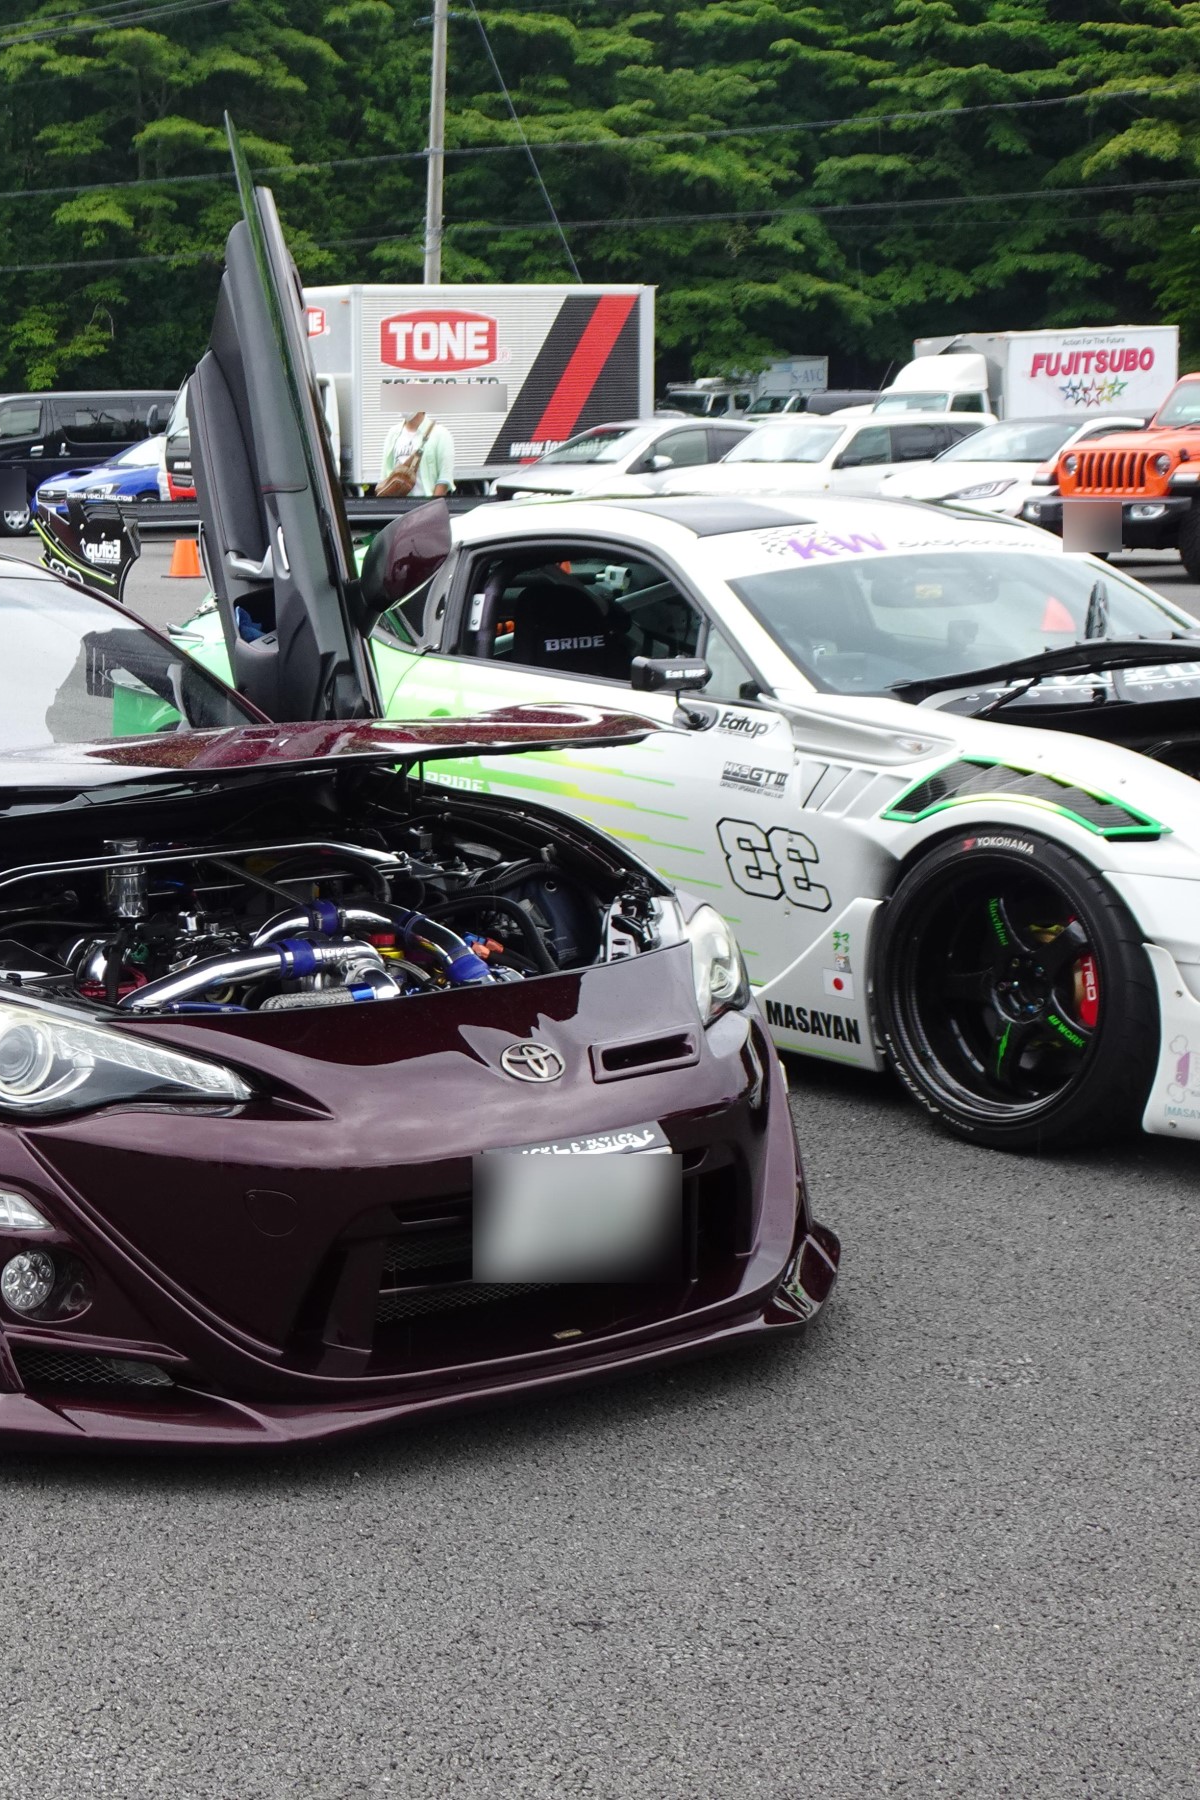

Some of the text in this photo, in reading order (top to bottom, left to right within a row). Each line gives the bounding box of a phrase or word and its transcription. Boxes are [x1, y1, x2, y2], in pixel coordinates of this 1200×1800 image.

[388, 321, 490, 361] TONE
[1029, 346, 1155, 378] FUJITSUBO
[544, 635, 605, 652] BRIDE
[722, 761, 751, 779] HKS
[976, 836, 1036, 854] YOKOHAMA
[1083, 956, 1097, 1001] TRD
[765, 999, 862, 1045] MASAYAN
[1057, 1022, 1086, 1048] WORK
